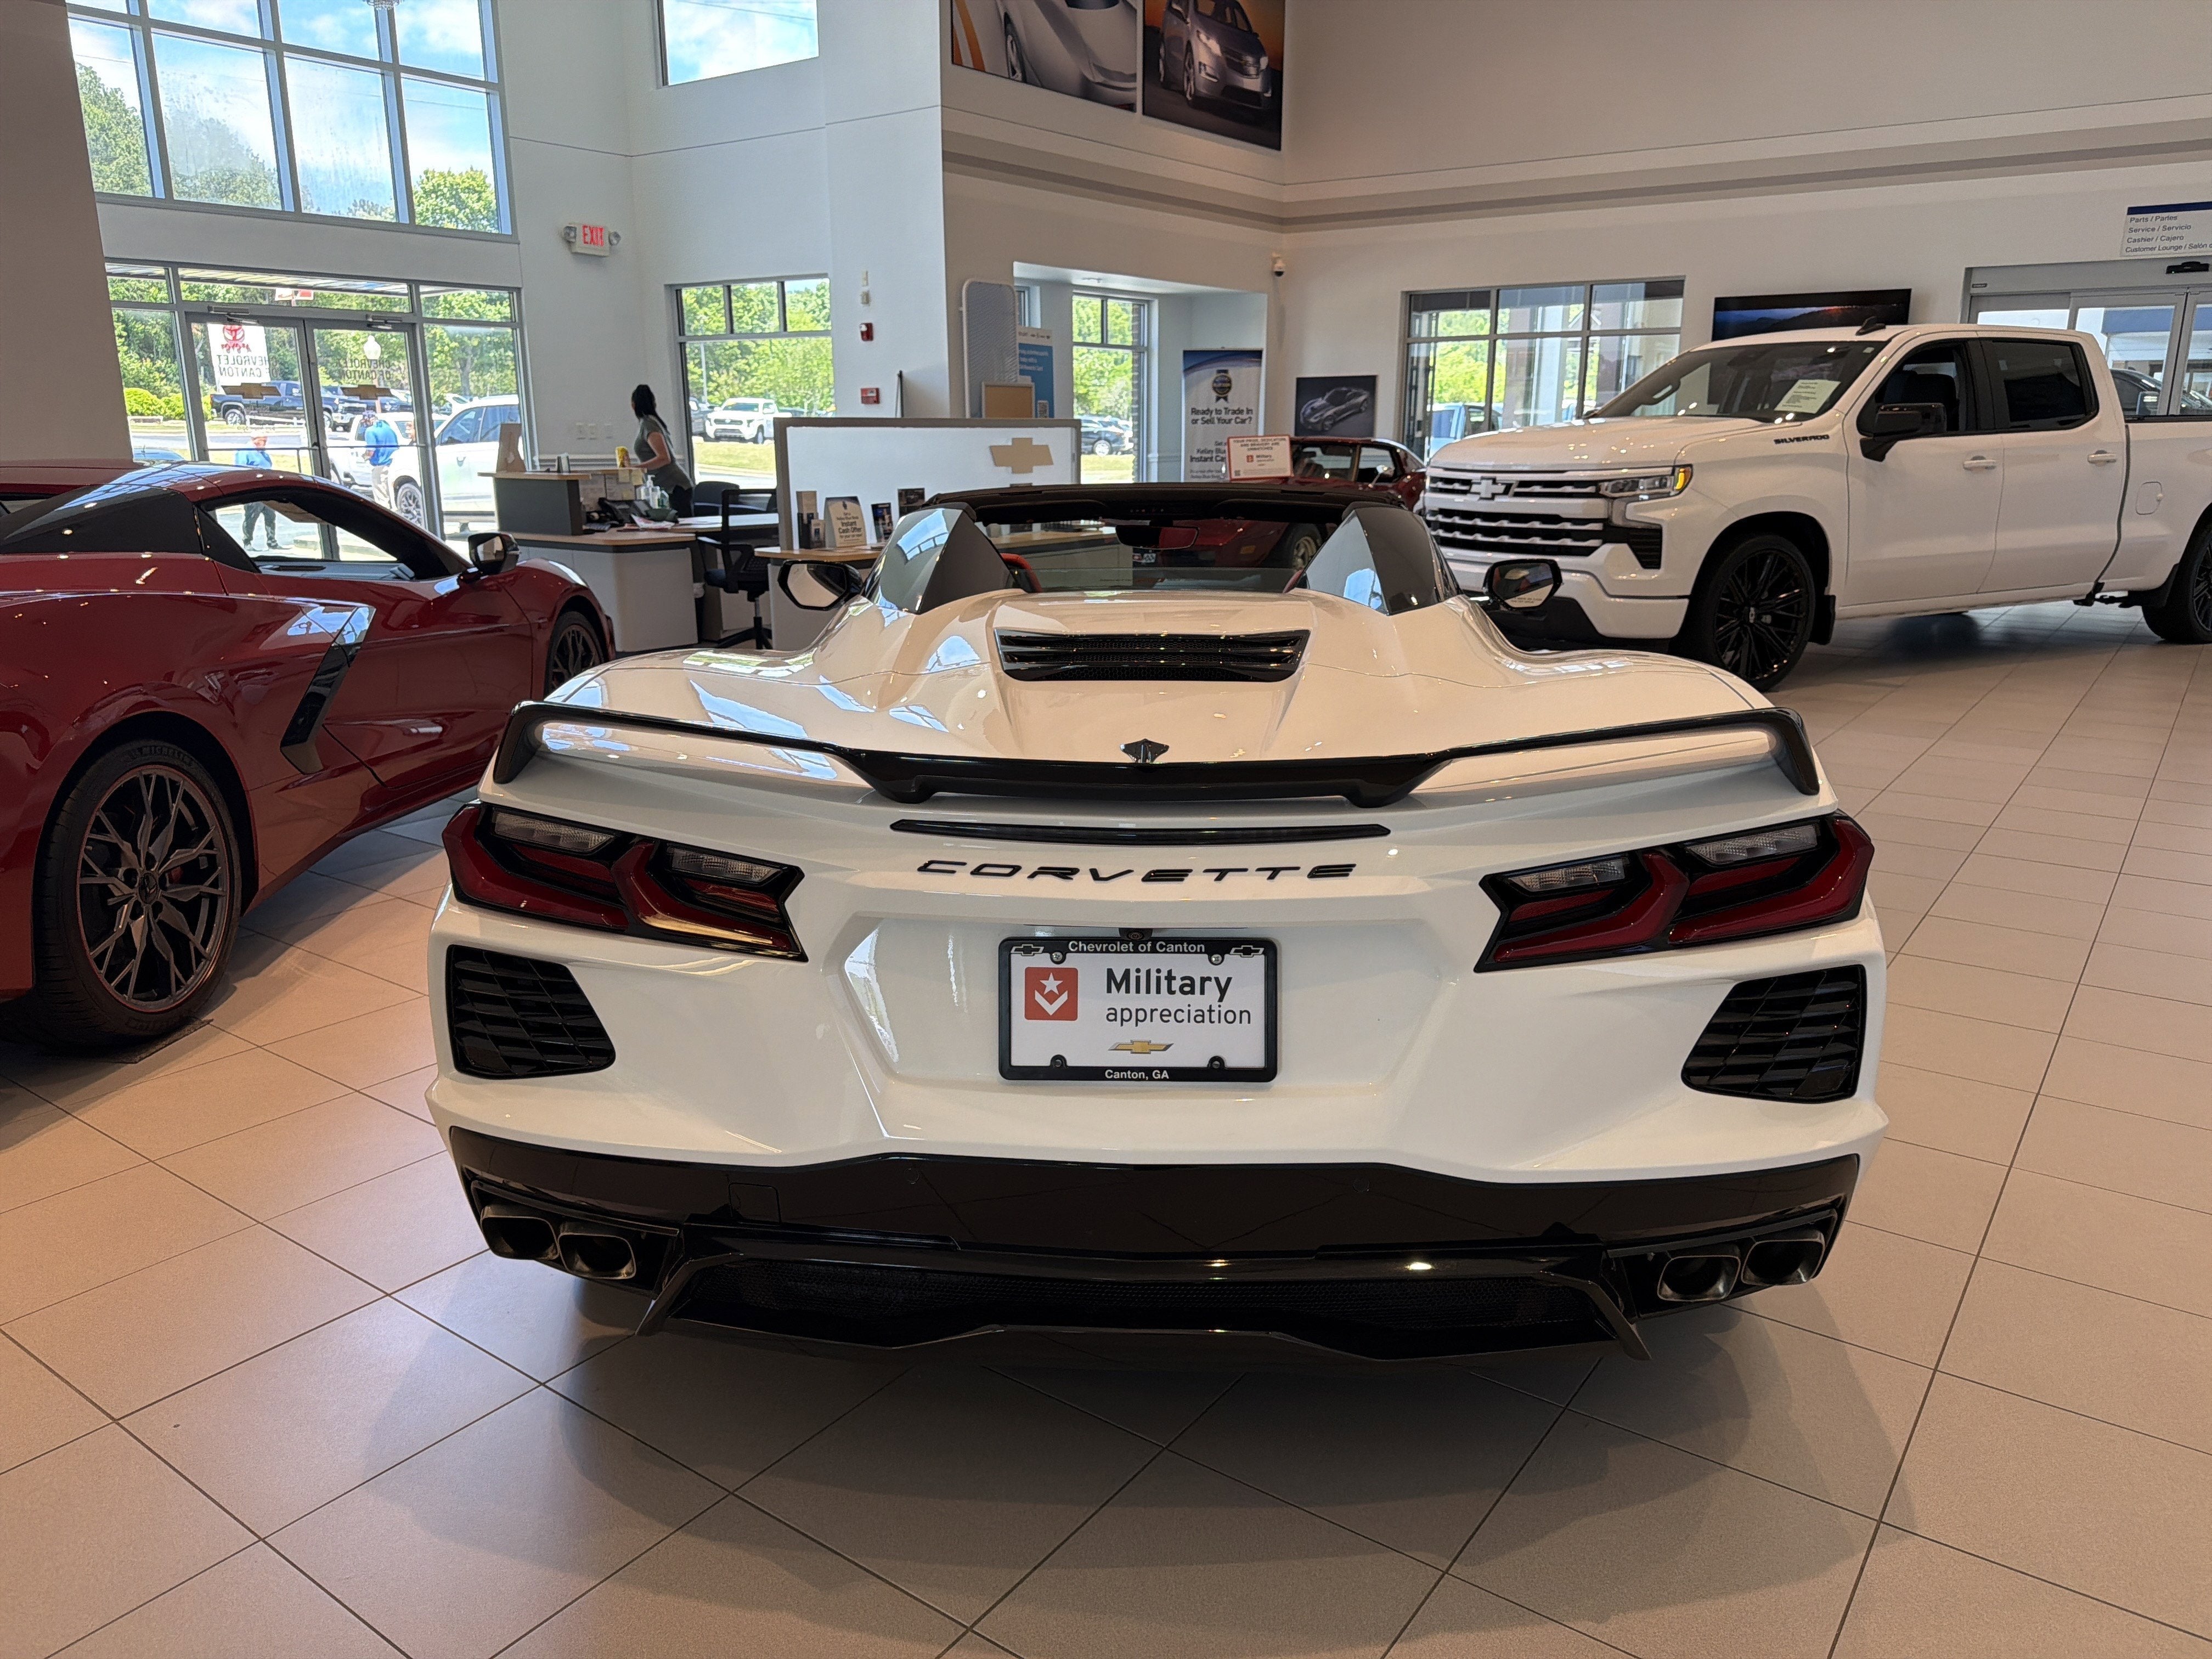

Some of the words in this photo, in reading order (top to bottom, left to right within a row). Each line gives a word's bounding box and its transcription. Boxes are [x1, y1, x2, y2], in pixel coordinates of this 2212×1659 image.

[582, 225, 604, 247] EXIT
[1190, 408, 1214, 416] Ready
[1224, 407, 1245, 415] Trade
[1234, 416, 1252, 425] Car?
[1774, 435, 1830, 444] SILVERADO
[917, 859, 1358, 882] CORVETTE
[1068, 941, 1134, 952] Chevrolet
[1138, 942, 1150, 952] of
[1153, 943, 1205, 953] Canton
[1105, 967, 1233, 1003] Military
[1105, 1005, 1251, 1027] appreciation
[1105, 1069, 1149, 1081] Canton,
[1152, 1070, 1170, 1080] GA
